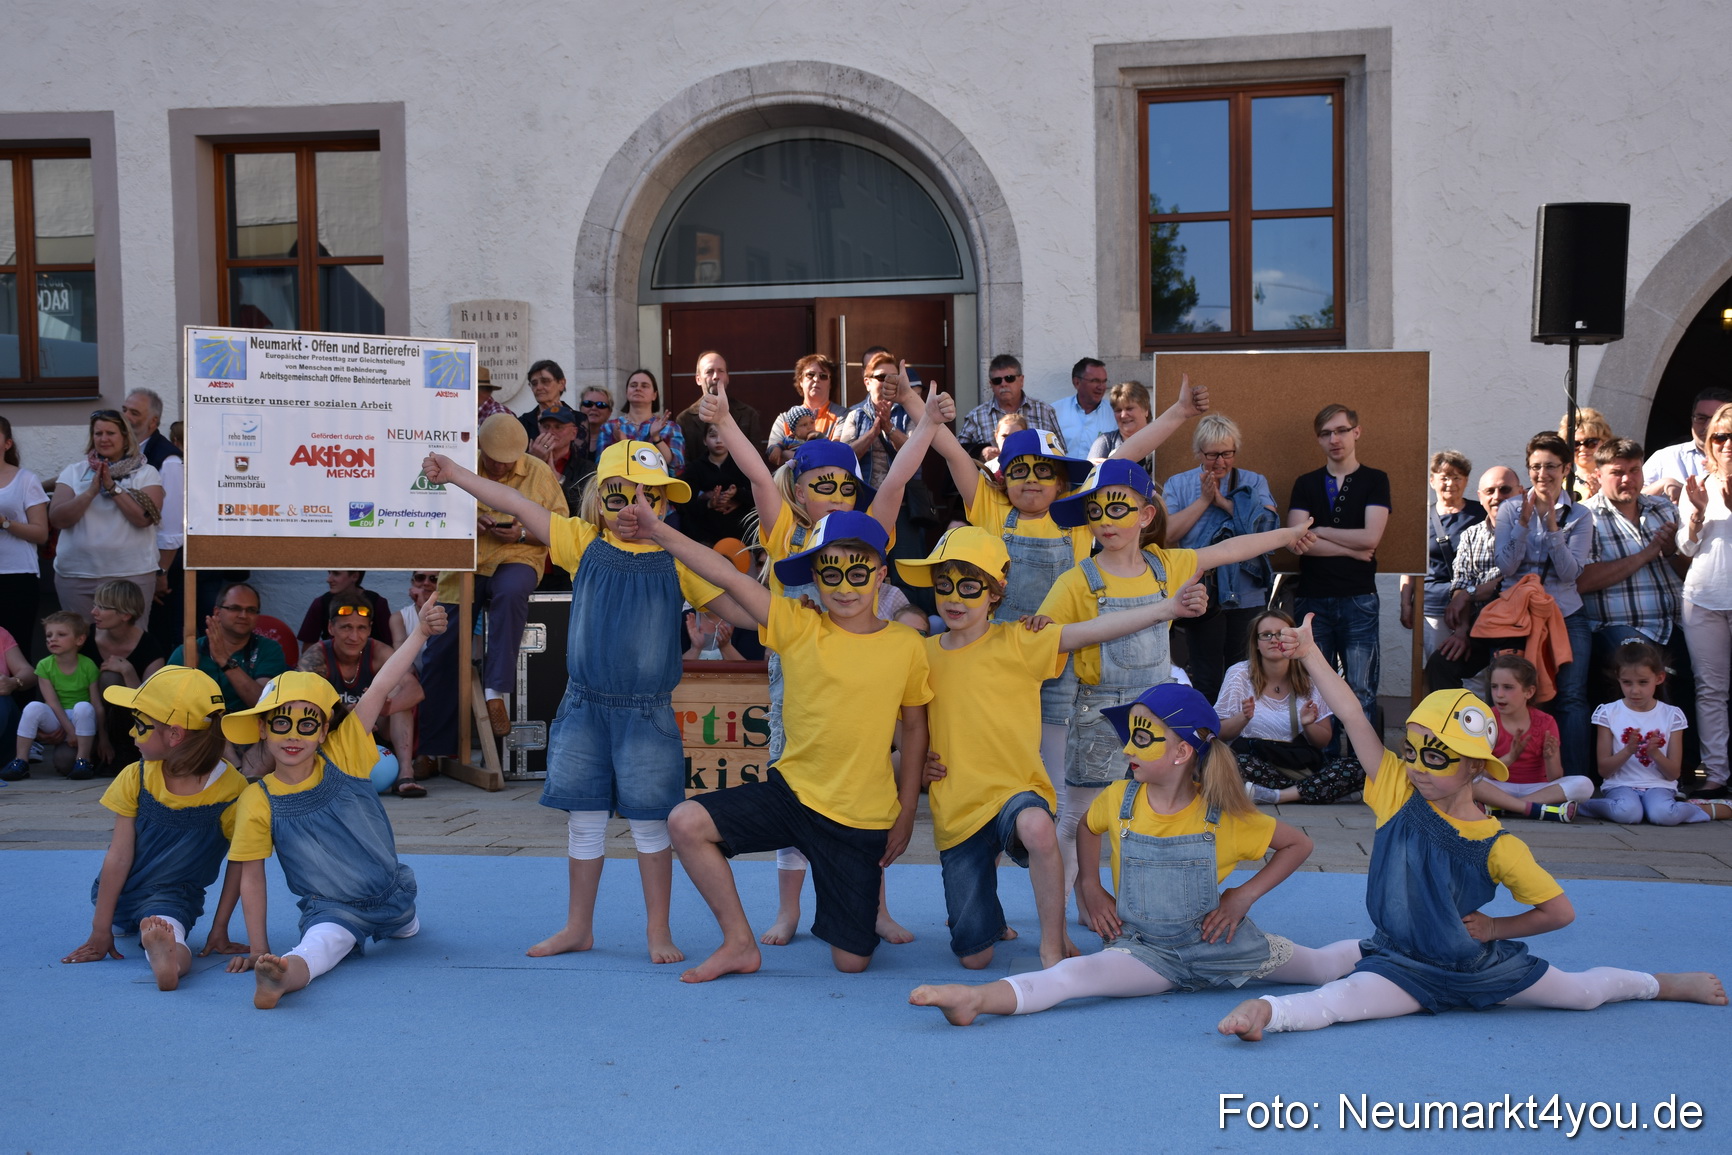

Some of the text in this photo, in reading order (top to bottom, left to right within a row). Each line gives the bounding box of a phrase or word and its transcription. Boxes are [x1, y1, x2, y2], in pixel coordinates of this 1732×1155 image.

[461, 309, 518, 322] Rathaus
[250, 336, 302, 351] Neumarkt
[311, 339, 339, 353] Offen
[341, 342, 360, 354] und
[363, 342, 420, 357] Barrierefrei
[265, 352, 310, 361] Europäischer
[311, 354, 346, 363] Protesttag
[359, 356, 405, 366] Gleichstellung
[298, 364, 332, 372] Menschen
[346, 366, 387, 375] Behinderung
[259, 371, 411, 386] Arbeitsgemeinschaft Offene Behindertenarbeit
[194, 394, 393, 410] Unterstützer unserer sozialen Arbeit
[228, 432, 257, 441] reha team
[310, 432, 343, 440] Gefördert
[387, 428, 458, 442] NEUMARKT
[326, 468, 375, 479] MENSCH
[217, 480, 266, 489] Lammsbräu
[287, 504, 298, 517] &
[377, 508, 447, 520] Dienstleistungen
